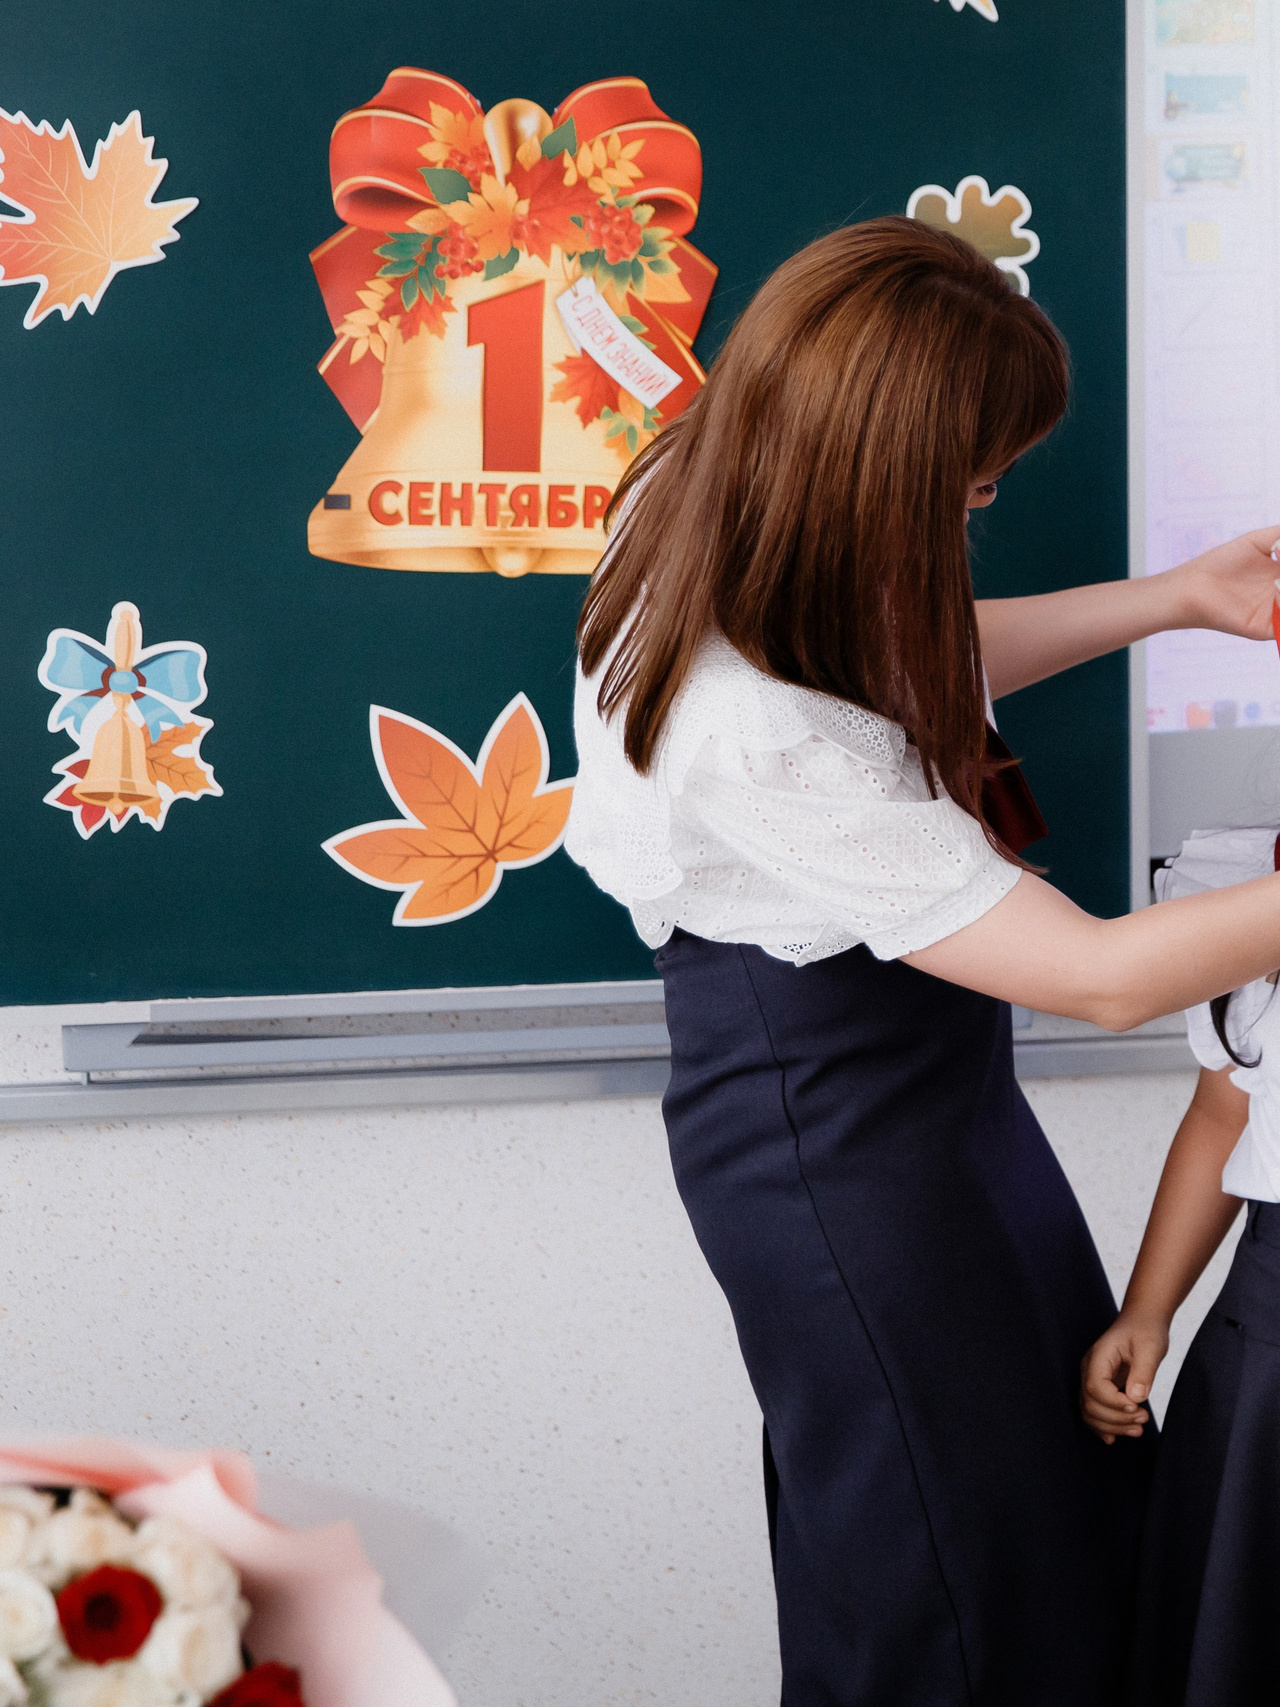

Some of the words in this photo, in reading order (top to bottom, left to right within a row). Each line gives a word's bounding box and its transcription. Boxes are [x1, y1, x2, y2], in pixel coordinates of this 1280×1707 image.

[571, 294, 593, 312] С
[467, 279, 545, 472] 1
[368, 480, 628, 528] СЕНТЯБР
